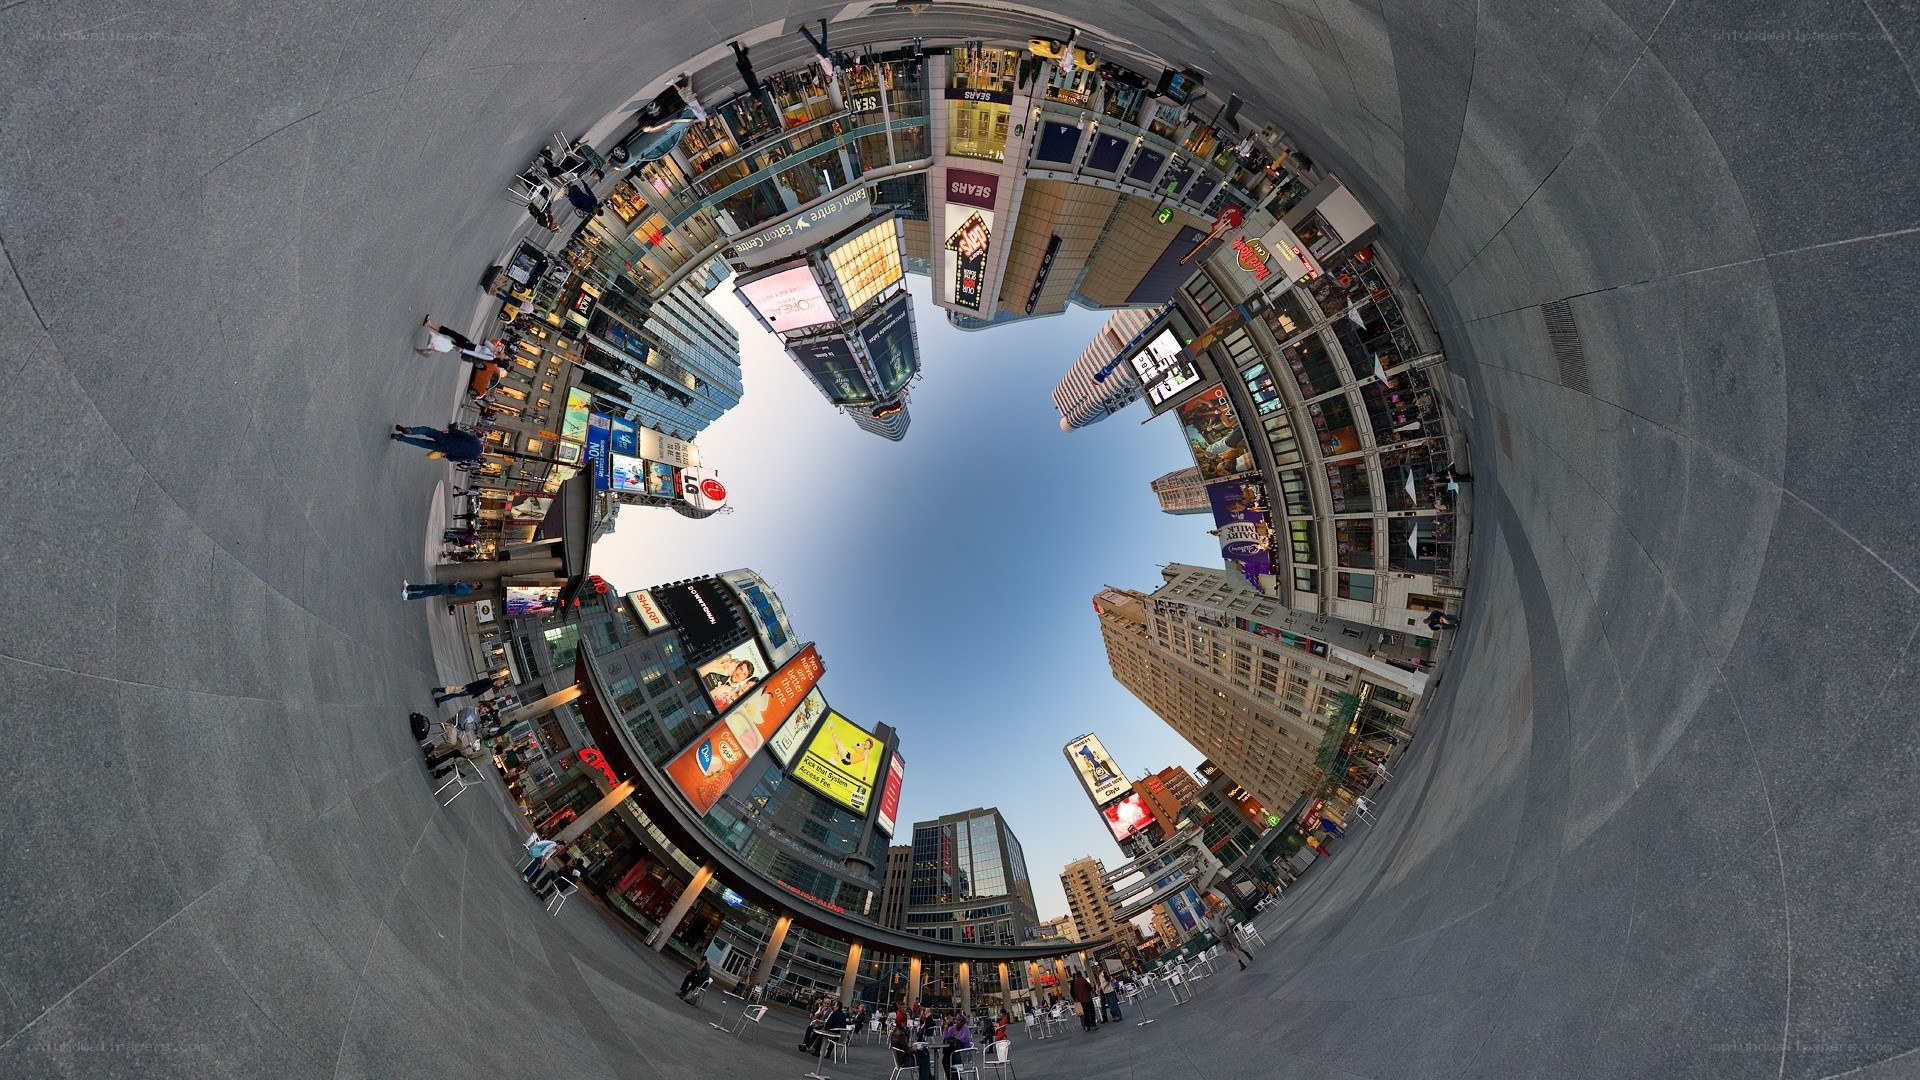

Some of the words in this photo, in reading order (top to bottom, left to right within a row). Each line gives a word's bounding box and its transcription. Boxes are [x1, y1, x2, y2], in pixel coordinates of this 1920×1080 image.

[964, 90, 991, 100] SEARS
[842, 187, 866, 206] Eaton
[951, 181, 991, 198] SEARS
[809, 200, 843, 222] Centre
[1157, 211, 1169, 224] P
[762, 223, 793, 244] Eaton
[959, 224, 986, 256] days
[733, 236, 764, 254] Centre
[1230, 234, 1253, 261] Rock
[1247, 255, 1270, 281] Hard
[1026, 254, 1050, 311] SEARS
[1213, 387, 1235, 421] ALDO
[684, 474, 699, 495] LG
[1225, 529, 1260, 540] DAIRY
[1226, 522, 1256, 532] MILK
[635, 594, 661, 625] SHARP
[799, 656, 815, 681] halves
[807, 654, 819, 671] Two
[786, 667, 804, 693] better
[795, 667, 807, 682] are
[772, 686, 787, 707] one.
[779, 676, 796, 699] than
[699, 744, 710, 762] Duo
[798, 765, 820, 781] Access
[819, 778, 833, 789] Fee.
[803, 756, 816, 768] Kick
[815, 764, 829, 775] that
[826, 771, 848, 787] System
[1104, 786, 1120, 796] Citytv
